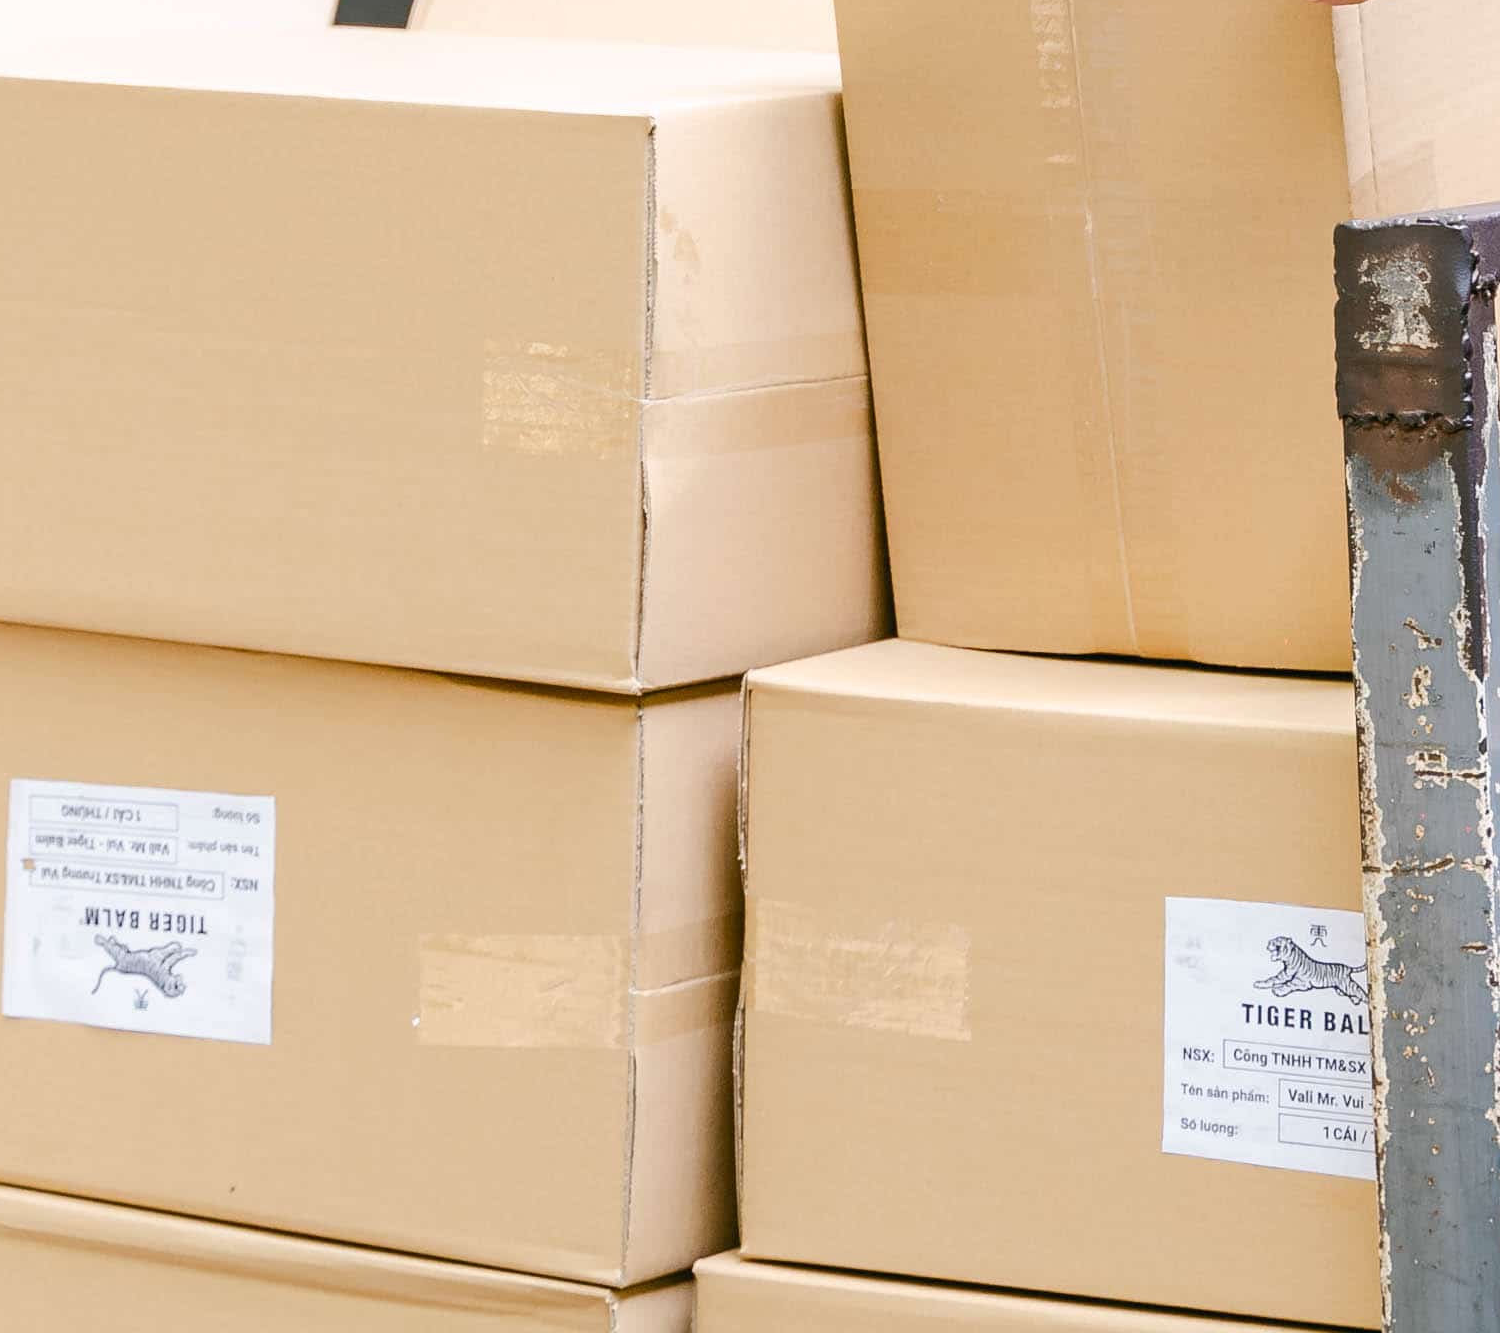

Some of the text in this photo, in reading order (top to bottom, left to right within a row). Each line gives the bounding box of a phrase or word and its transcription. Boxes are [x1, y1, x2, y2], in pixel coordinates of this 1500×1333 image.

[83, 906, 208, 934] TIGER BALM
[1242, 1003, 1368, 1035] TIGER BAL
[1183, 1047, 1366, 1074] NSX: Công TNHH TM&SX
[1288, 1088, 1313, 1104] Vali
[1318, 1093, 1338, 1107] Mr.
[1343, 1094, 1364, 1109] Vui
